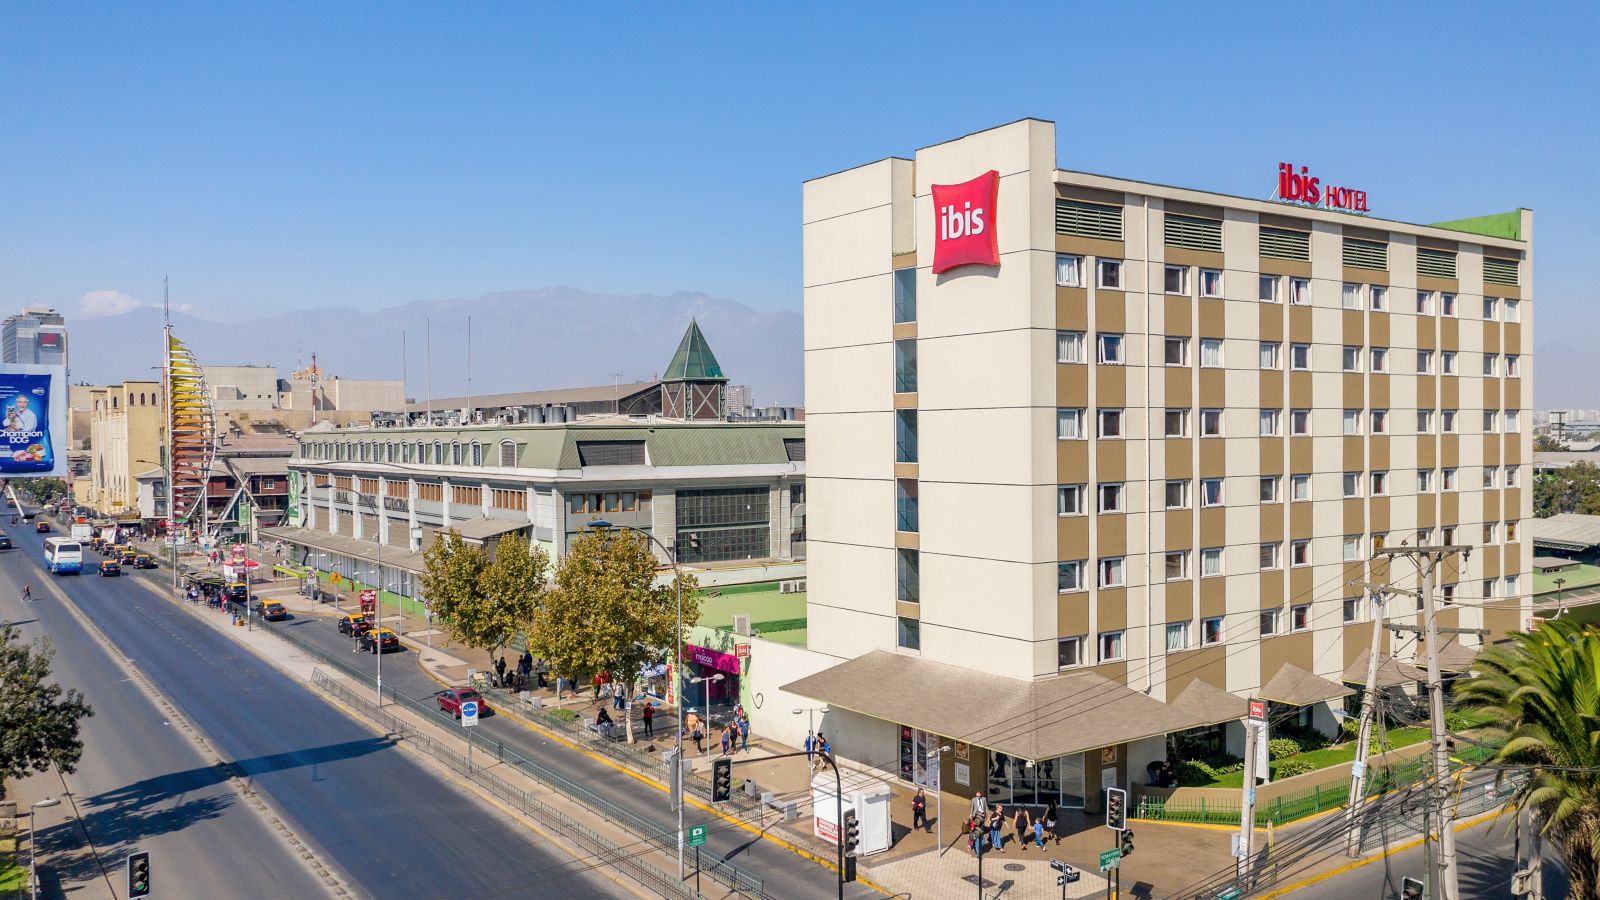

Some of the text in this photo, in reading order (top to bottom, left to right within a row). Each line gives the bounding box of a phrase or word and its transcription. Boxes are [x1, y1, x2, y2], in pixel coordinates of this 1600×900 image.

[1279, 163, 1371, 212] ibis HOTEL
[941, 201, 984, 240] ibis
